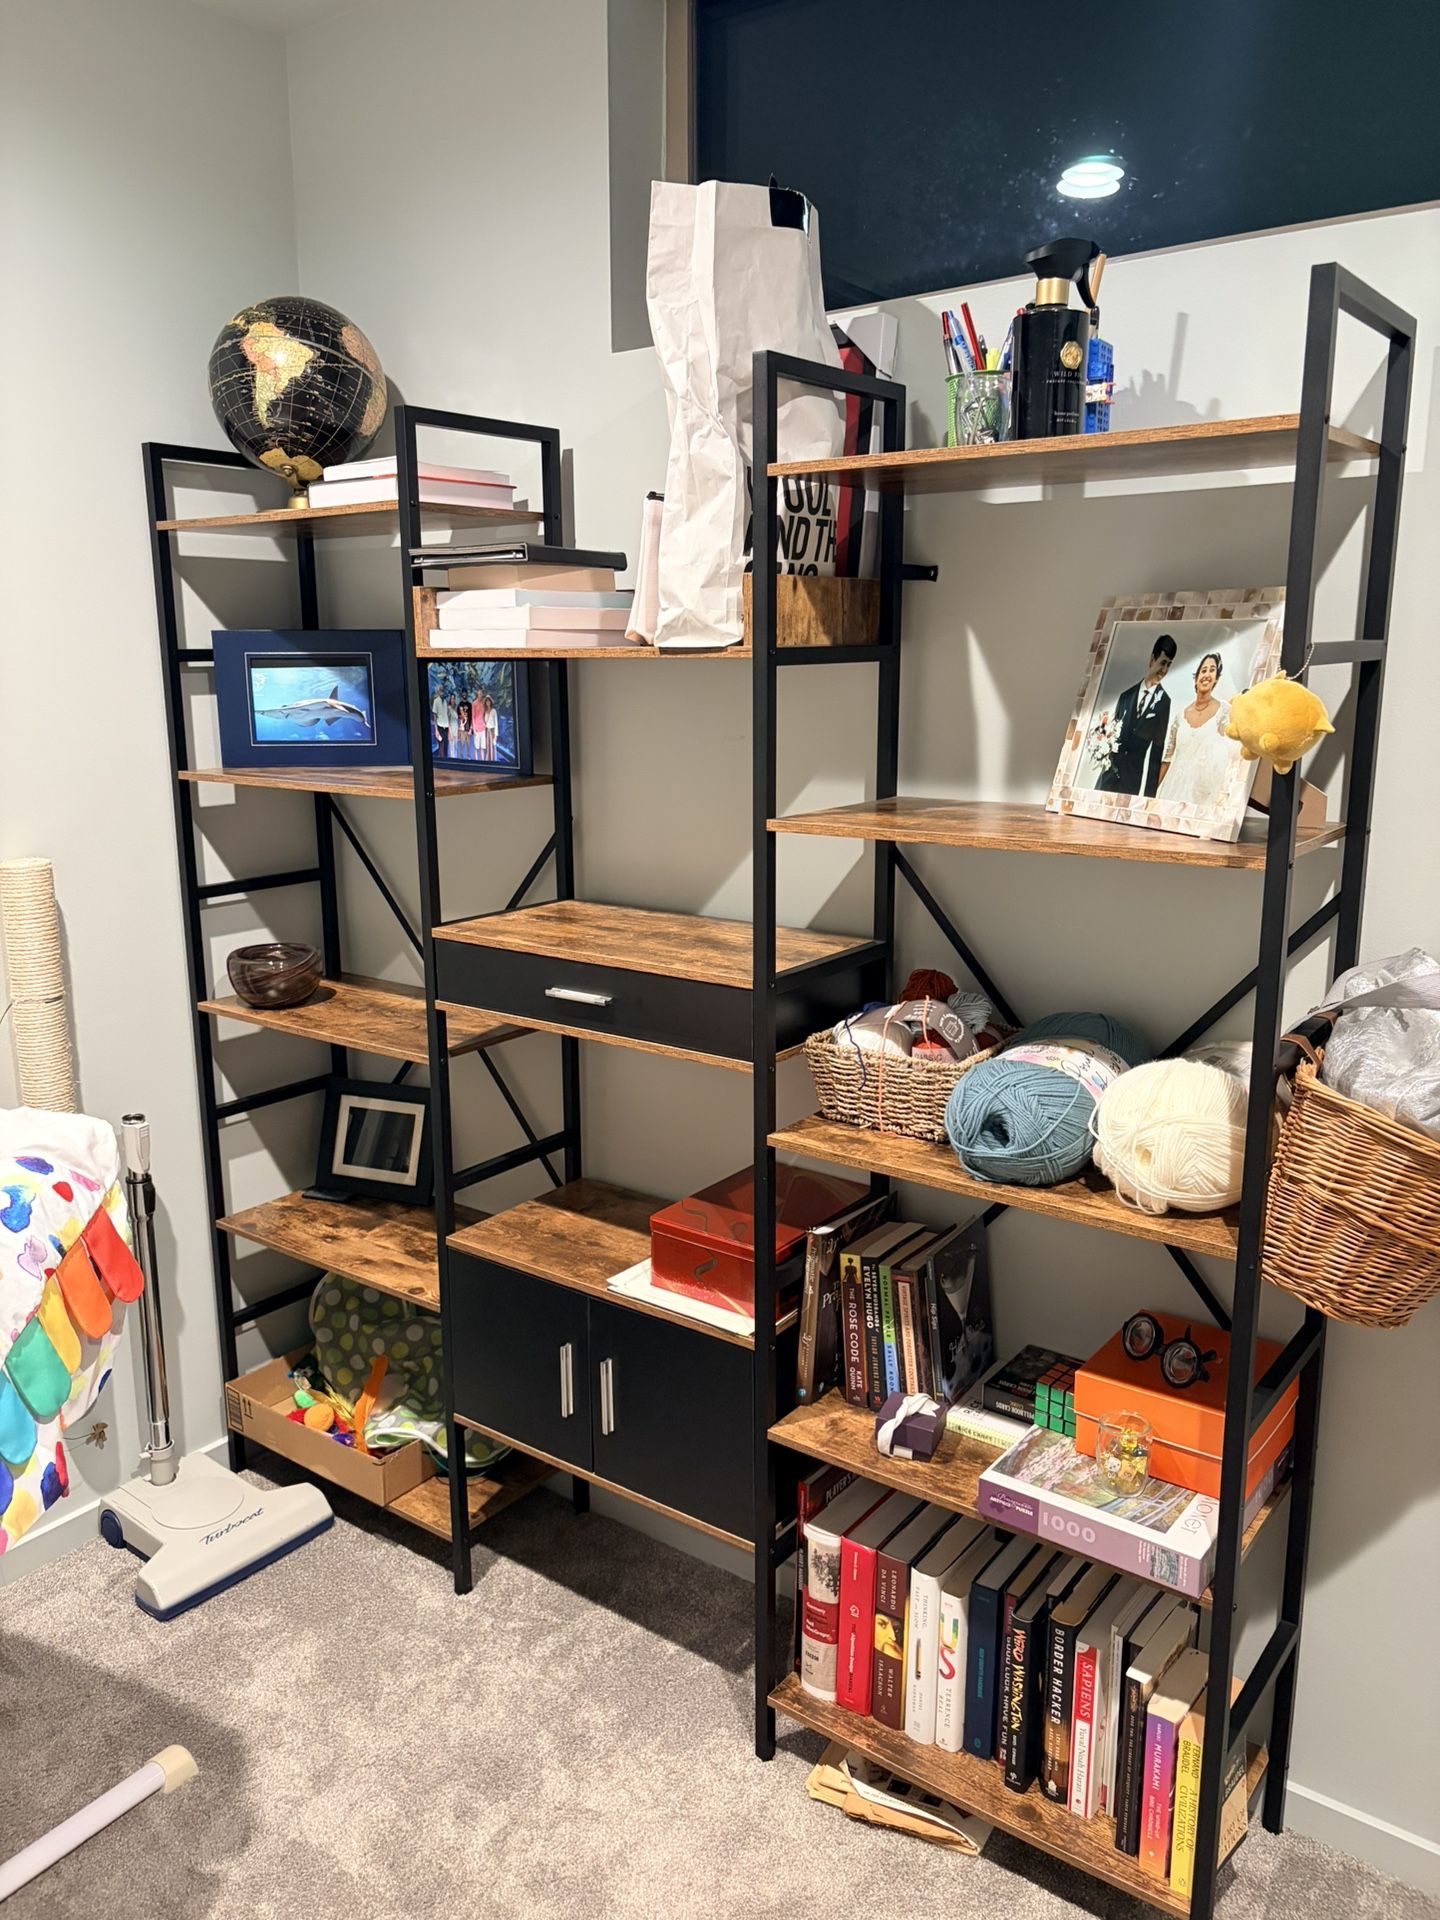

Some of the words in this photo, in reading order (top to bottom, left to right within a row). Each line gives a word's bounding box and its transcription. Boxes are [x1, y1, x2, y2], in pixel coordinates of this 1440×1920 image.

[745, 466, 832, 517] OOL
[815, 518, 838, 563] TH
[863, 1265, 873, 1300] EVELYN
[849, 1302, 858, 1330] ROSE
[866, 1301, 874, 1329] HUGO
[850, 1334, 860, 1363] CODE
[849, 1367, 857, 1390] QUINN
[995, 1401, 1012, 1412] CARDS
[1012, 1406, 1035, 1420] PELLBOOK
[198, 1507, 264, 1545] Turbocat
[1042, 1511, 1096, 1544] 1000
[880, 1568, 886, 1579] DA
[890, 1569, 898, 1611] LEONARDO
[1012, 1628, 1027, 1662] WEIRD
[1052, 1628, 1065, 1675] BORDER
[877, 1659, 885, 1697] ISAACSON
[886, 1668, 895, 1698] WALTER
[1080, 1661, 1093, 1719] SAPIENS
[943, 1688, 953, 1729] TERRENCE
[1002, 1695, 1010, 1723] HAVE
[1010, 1664, 1026, 1731] WASHINGTON
[1050, 1677, 1063, 1725] HACKER
[1001, 1724, 1009, 1745] FUN
[1079, 1727, 1087, 1750] Yuval
[1077, 1749, 1086, 1769] Noah
[1151, 1743, 1163, 1791] MURAKAMI
[1181, 1739, 1192, 1774] BRAUDEL
[1191, 1743, 1201, 1779] FERNAND
[1075, 1769, 1085, 1793] Harari
[1176, 1784, 1188, 1852] CIVILIZATIONS
[1187, 1797, 1197, 1839] HISTORY
[1186, 1839, 1194, 1851] OF
